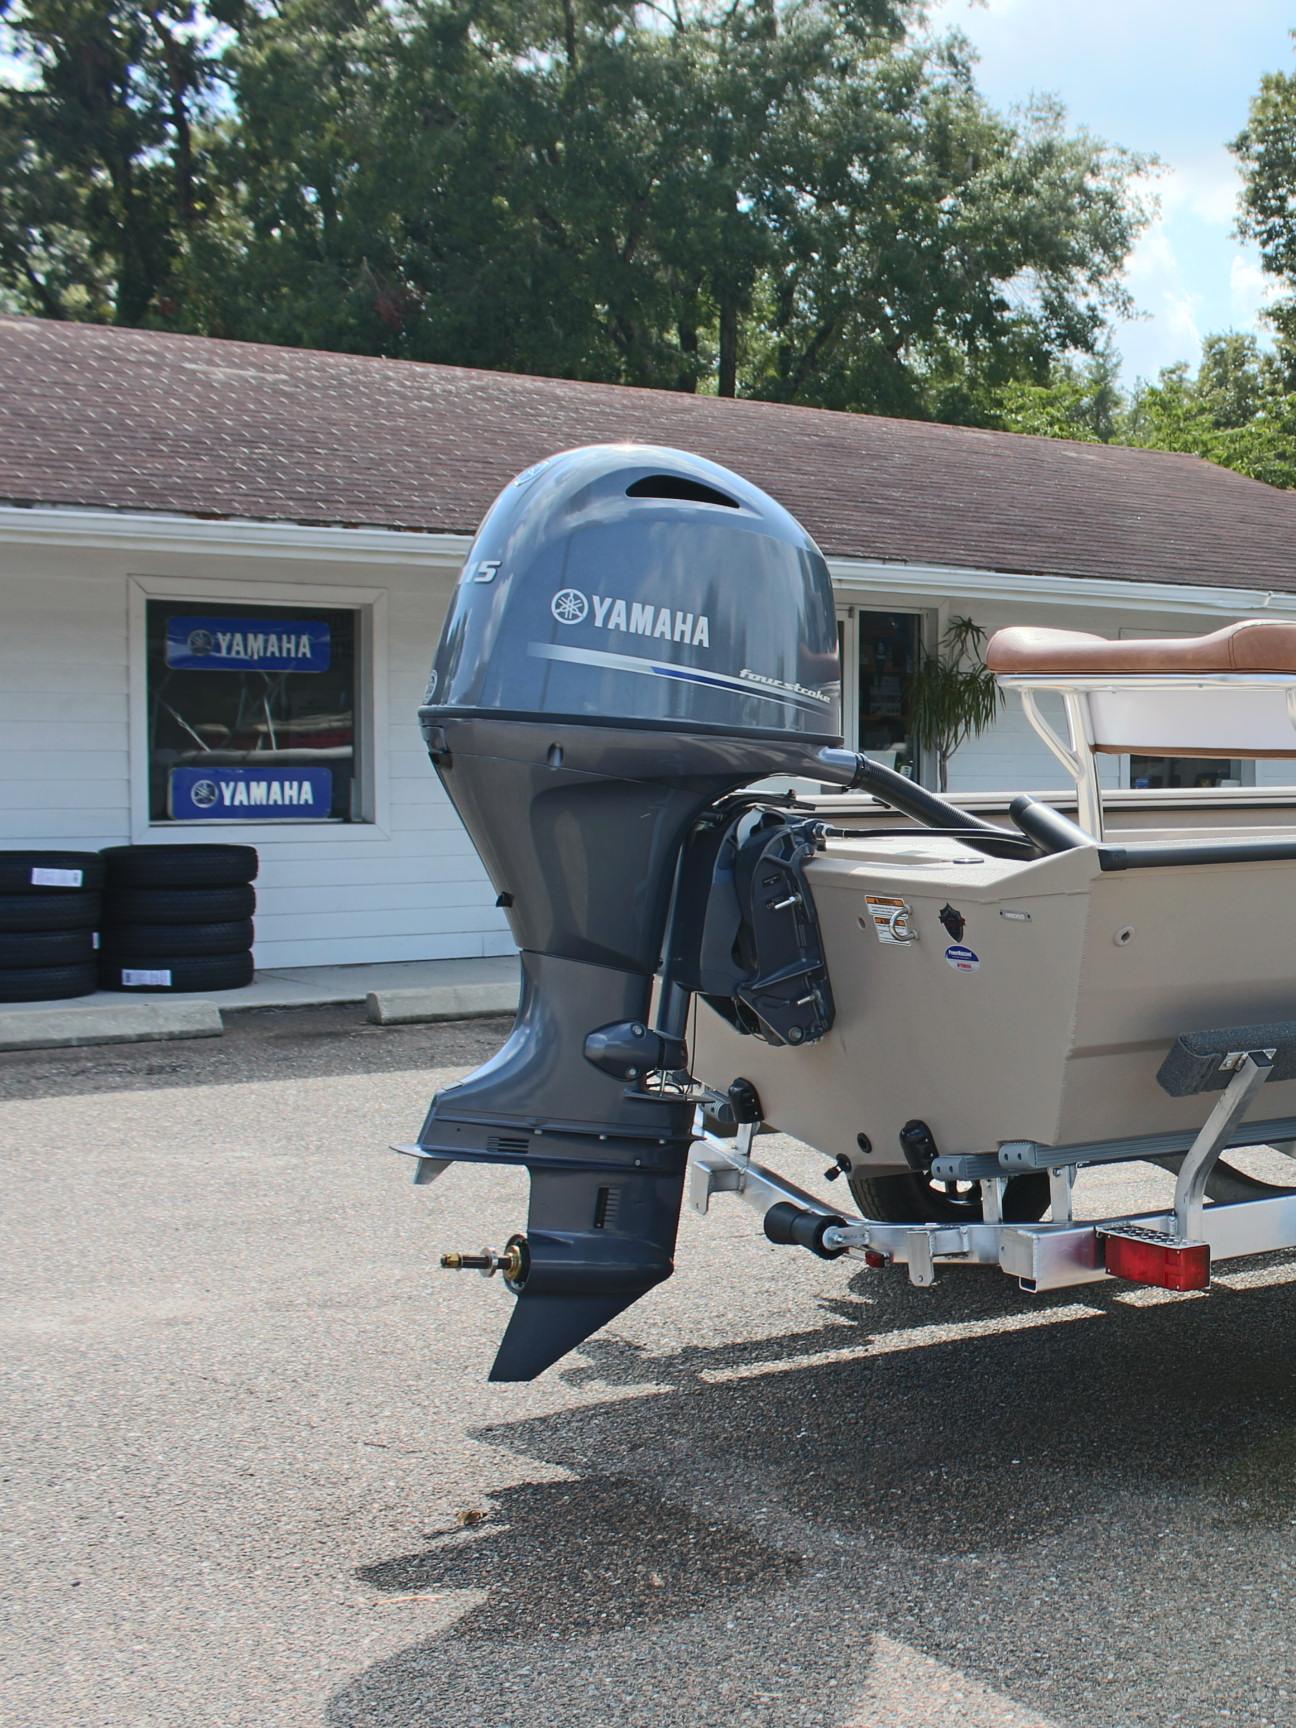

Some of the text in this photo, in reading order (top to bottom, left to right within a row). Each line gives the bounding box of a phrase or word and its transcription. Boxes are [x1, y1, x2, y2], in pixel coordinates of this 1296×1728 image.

[592, 594, 710, 648] YAMAHA
[216, 631, 312, 659] YAMAHA
[219, 780, 314, 806] YAMAHA
